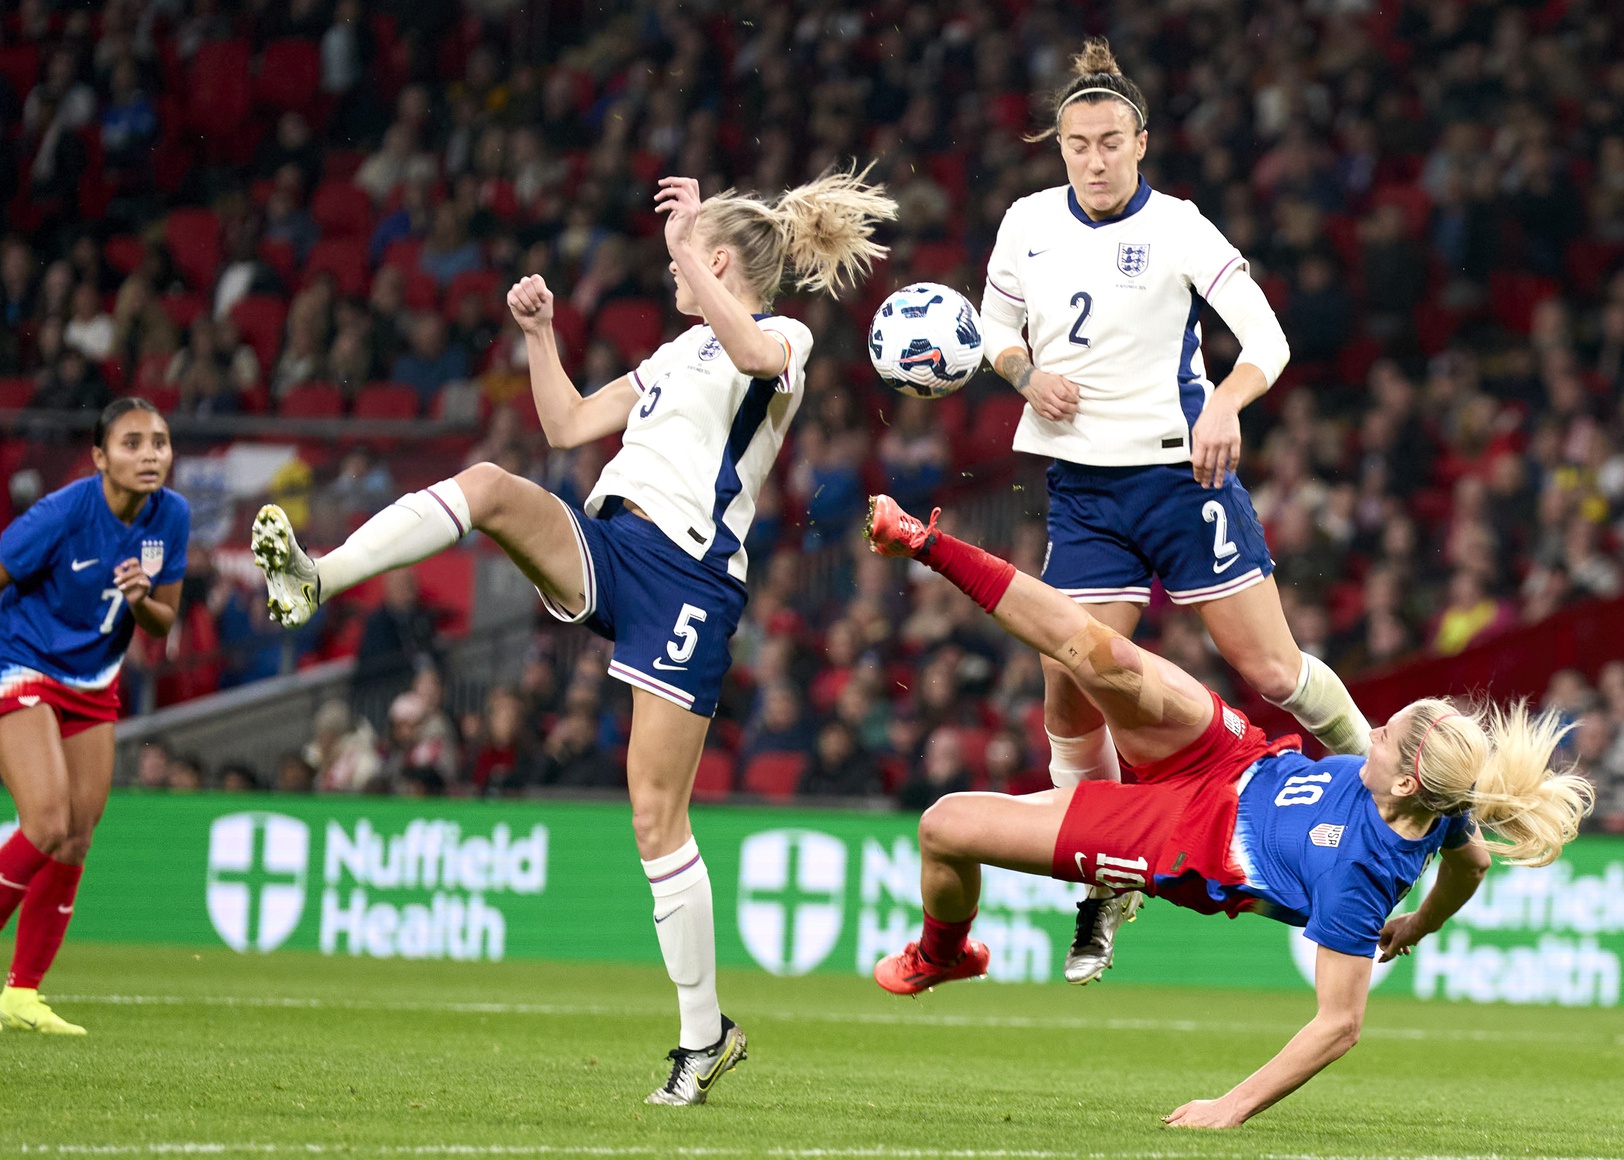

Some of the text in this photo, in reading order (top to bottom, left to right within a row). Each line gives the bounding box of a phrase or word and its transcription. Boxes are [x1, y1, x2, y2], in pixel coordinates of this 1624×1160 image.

[1068, 291, 1093, 348] 2
[640, 381, 662, 420] 5
[1201, 500, 1237, 559] 2
[99, 588, 124, 634] 7
[666, 603, 707, 663] 5
[1274, 772, 1332, 807] 10
[324, 818, 549, 895] Nuffield
[1327, 827, 1342, 846] USA
[1096, 853, 1148, 889] 10
[319, 887, 506, 962] Health
[1413, 929, 1621, 1007] Health
